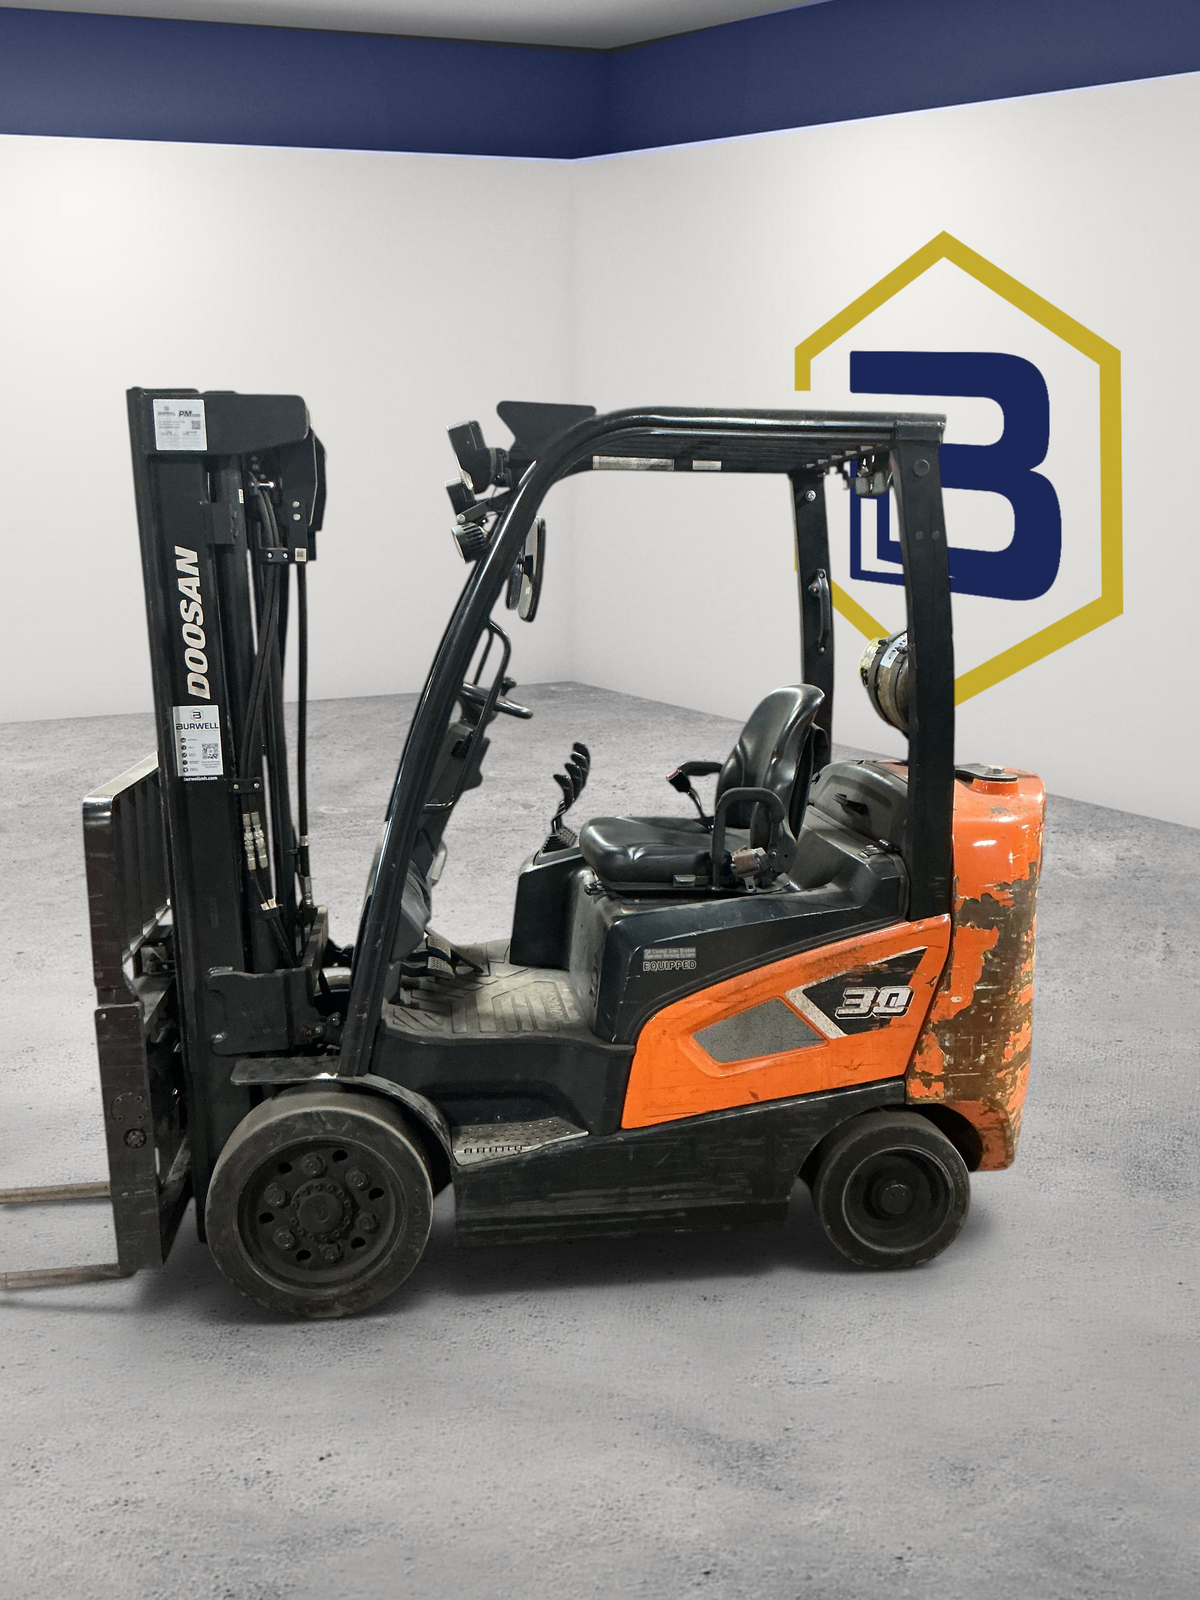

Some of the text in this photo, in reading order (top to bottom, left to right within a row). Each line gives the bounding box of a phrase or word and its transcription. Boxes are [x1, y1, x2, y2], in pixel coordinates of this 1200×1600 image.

[174, 545, 211, 700] DOOSAN
[176, 722, 219, 730] BURWELL
[643, 960, 697, 971] EQUIPPED
[835, 986, 915, 1019] 30
